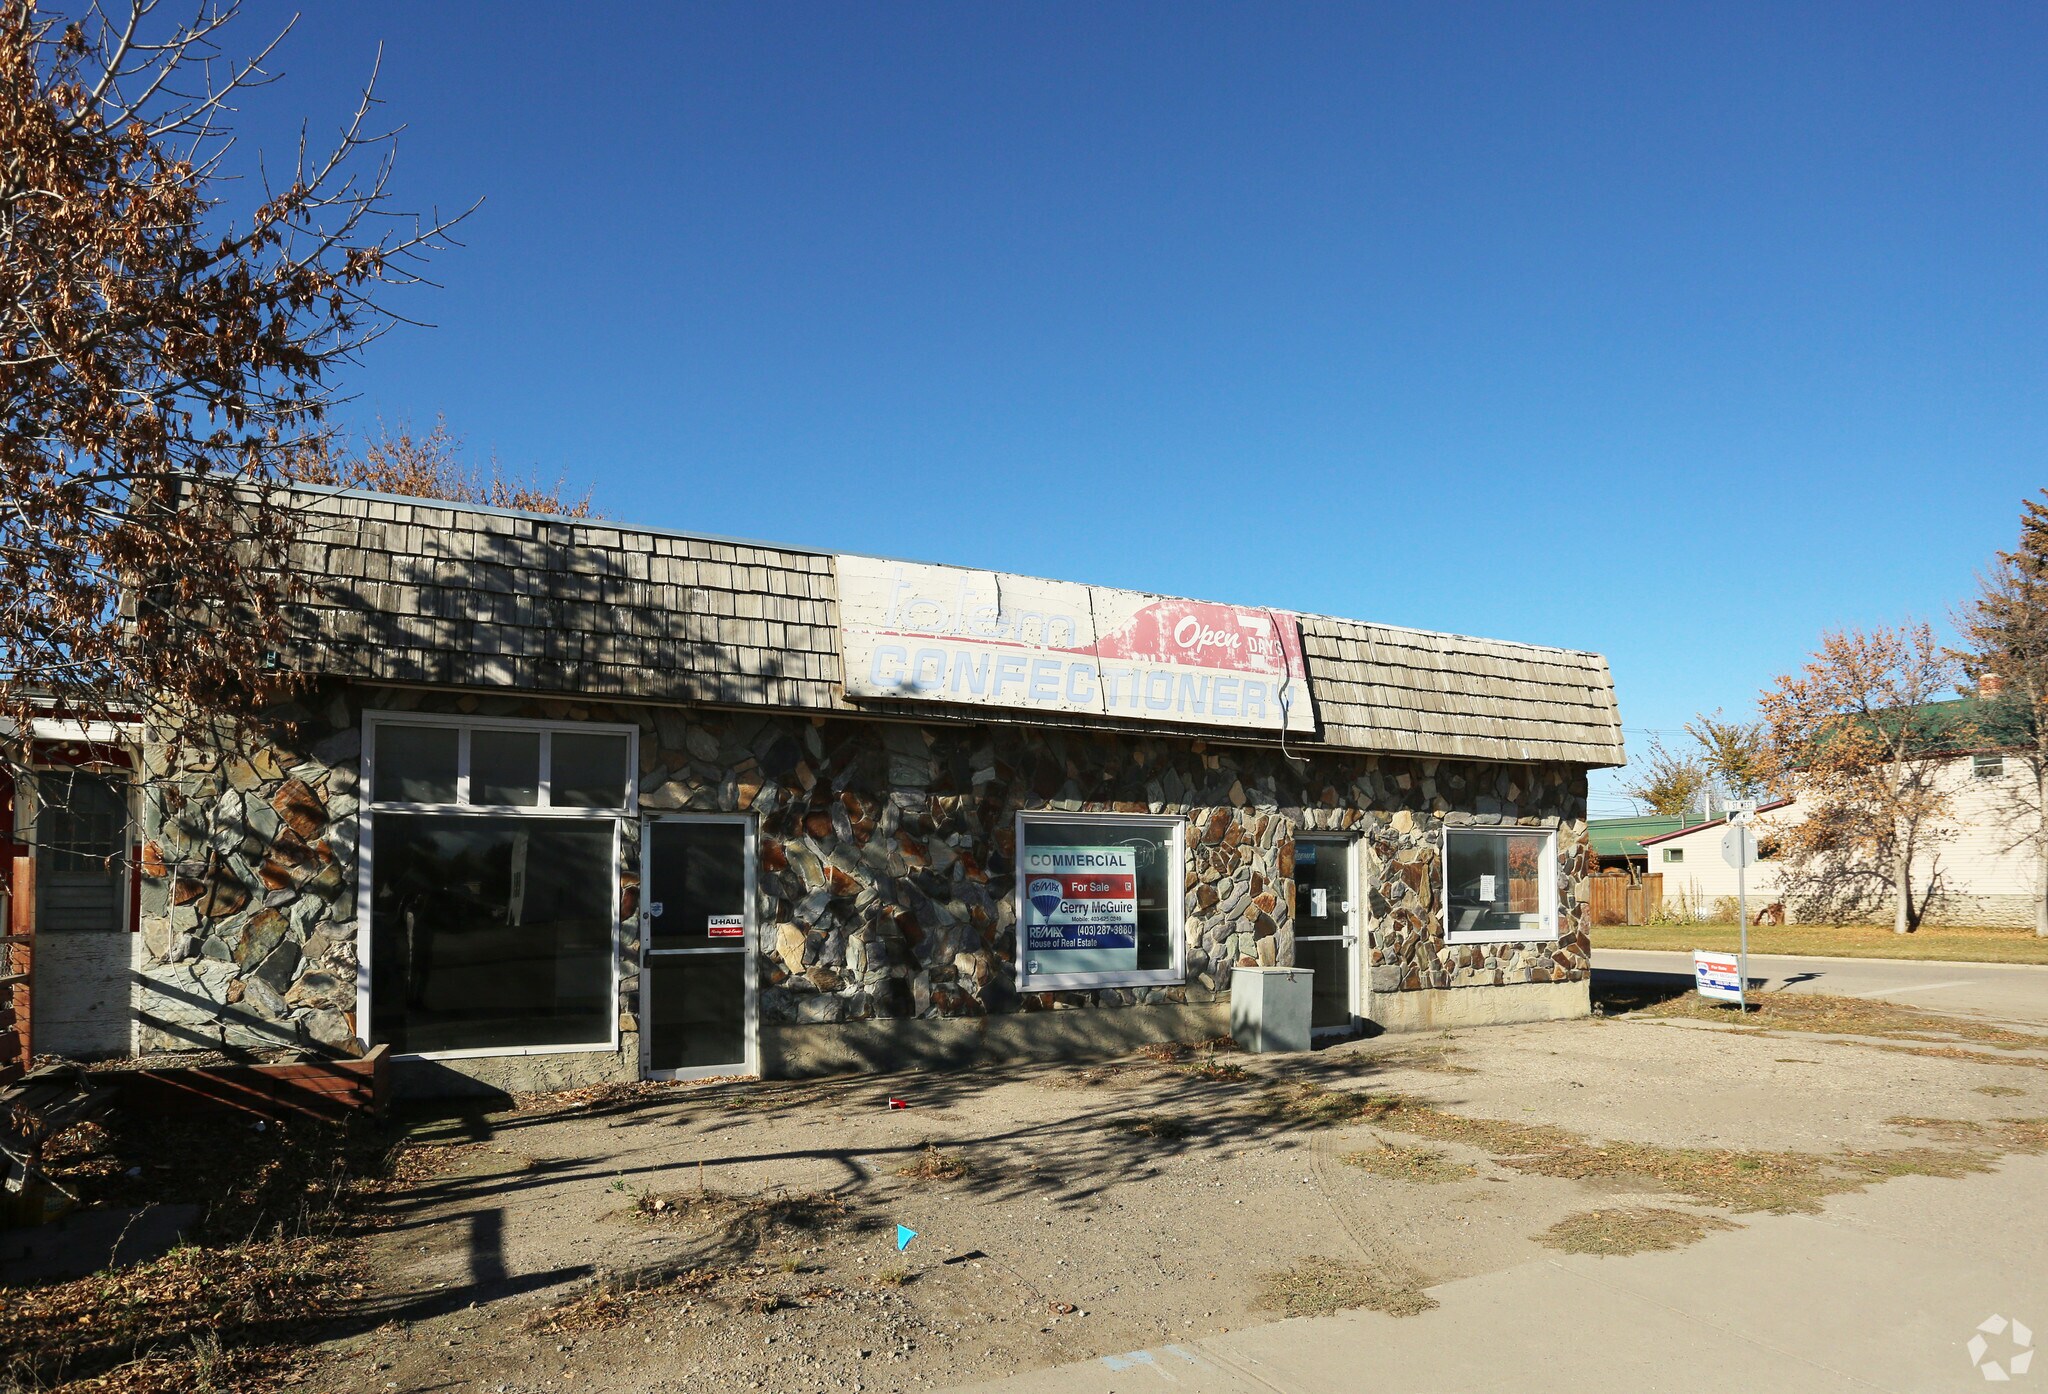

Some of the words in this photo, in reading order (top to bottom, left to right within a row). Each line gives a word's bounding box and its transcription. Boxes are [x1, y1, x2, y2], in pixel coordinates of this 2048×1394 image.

[1174, 615, 1241, 653] Open
[1247, 636, 1284, 657] DAYS
[869, 644, 1295, 720] CONFECTIONERY
[1031, 854, 1127, 867] COMMERCIAL
[1031, 881, 1060, 893] RE/MAX
[1071, 882, 1088, 892] For
[1089, 882, 1110, 892] Sale
[1060, 901, 1089, 916] Gerry
[1091, 901, 1133, 914] McGuire
[1029, 926, 1064, 938] RE/MAX
[1029, 939, 1051, 948] House
[1052, 939, 1060, 948] of
[1061, 939, 1076, 947] Real
[1077, 939, 1098, 947] Estate
